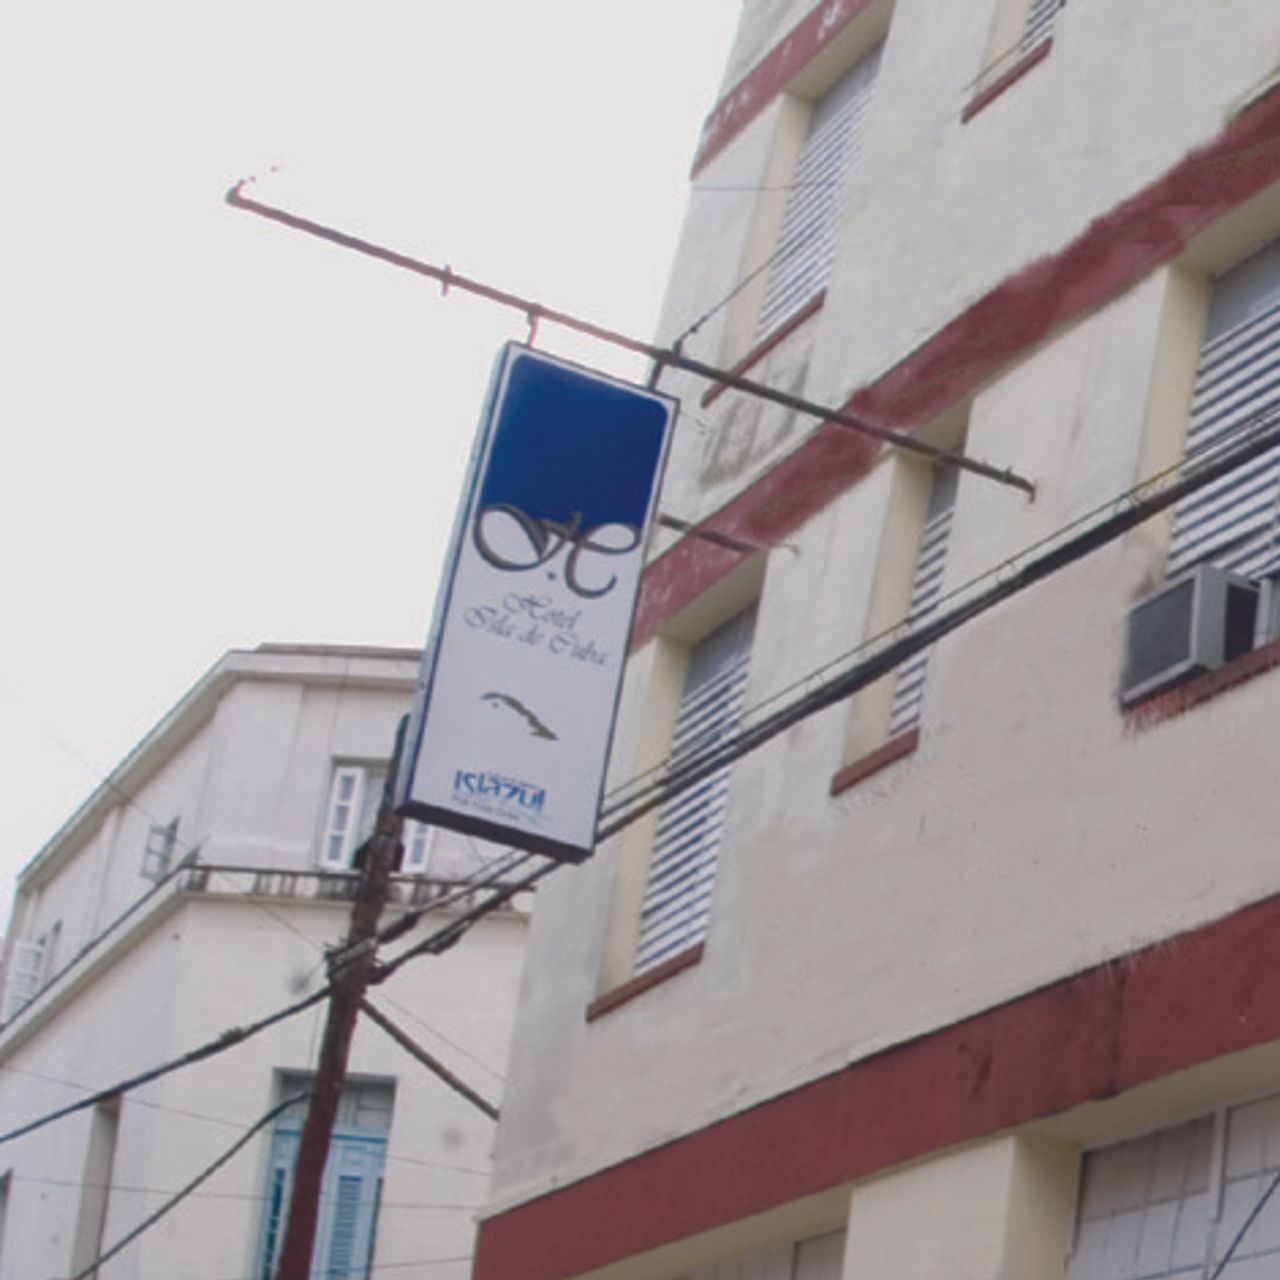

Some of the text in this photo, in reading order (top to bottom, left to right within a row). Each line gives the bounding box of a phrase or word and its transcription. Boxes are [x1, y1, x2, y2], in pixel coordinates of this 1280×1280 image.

[503, 593, 582, 630] Hotel
[518, 624, 545, 646] de
[549, 631, 609, 665] Cuba
